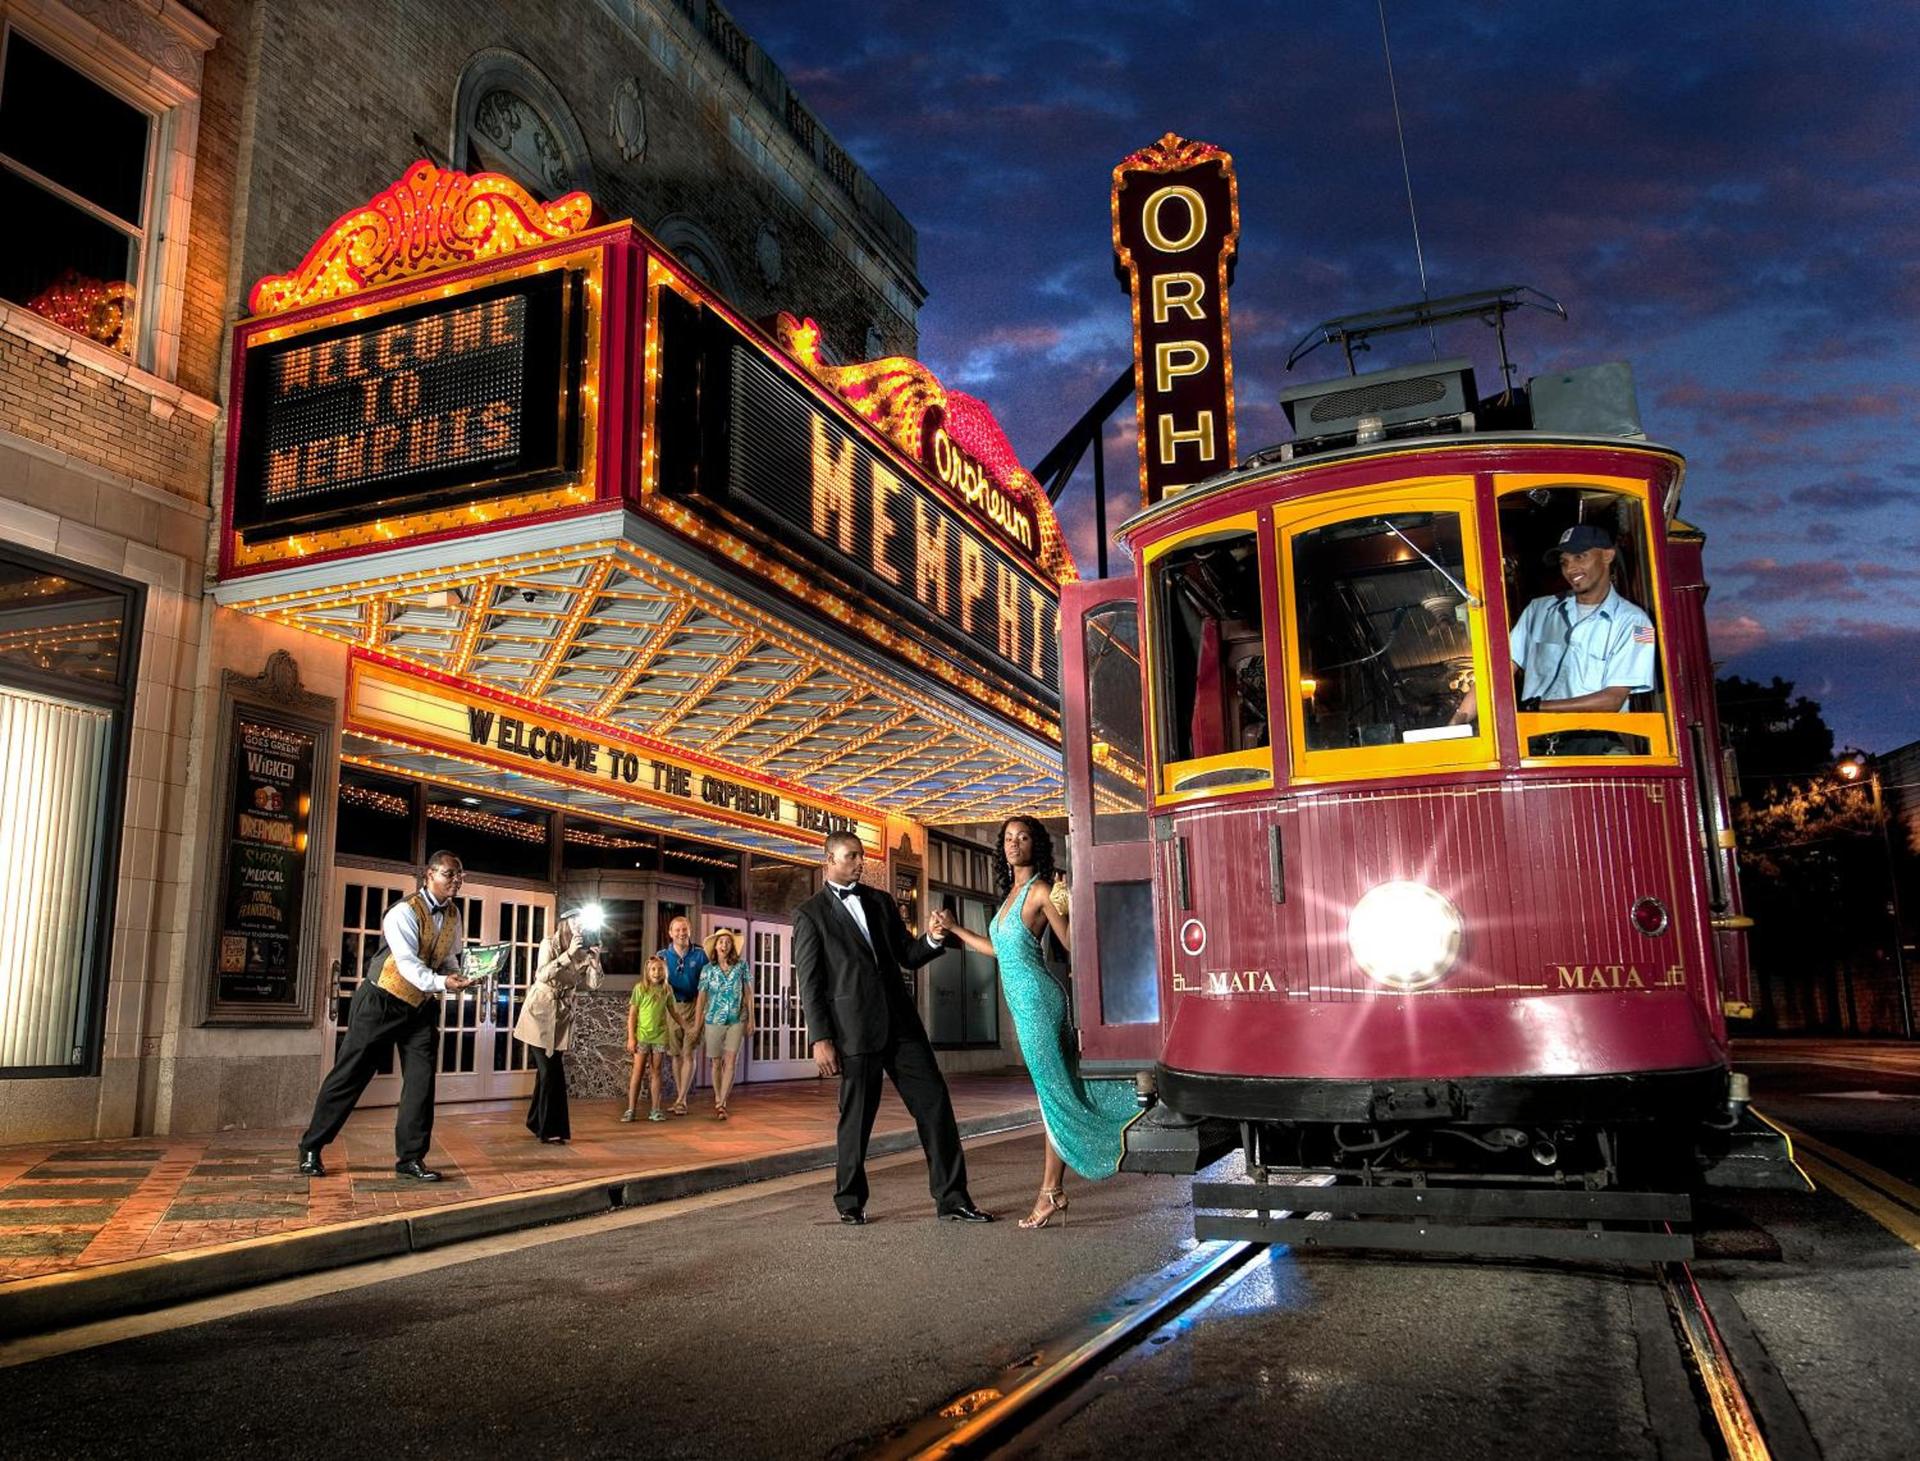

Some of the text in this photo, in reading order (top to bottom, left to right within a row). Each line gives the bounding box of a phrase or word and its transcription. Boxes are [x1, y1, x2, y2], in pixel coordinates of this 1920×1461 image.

[281, 297, 516, 395] WELCOME
[1142, 185, 1216, 500] ORPH
[360, 369, 421, 424] TO
[266, 399, 513, 495] MEMPHIS
[934, 428, 1033, 551] Orpheum
[811, 411, 1061, 680] MEMPHI
[467, 706, 859, 835] WELCOME TO THE ORPHEUM THEATRE
[1207, 970, 1277, 993] MATA
[1557, 964, 1646, 989] MATA
